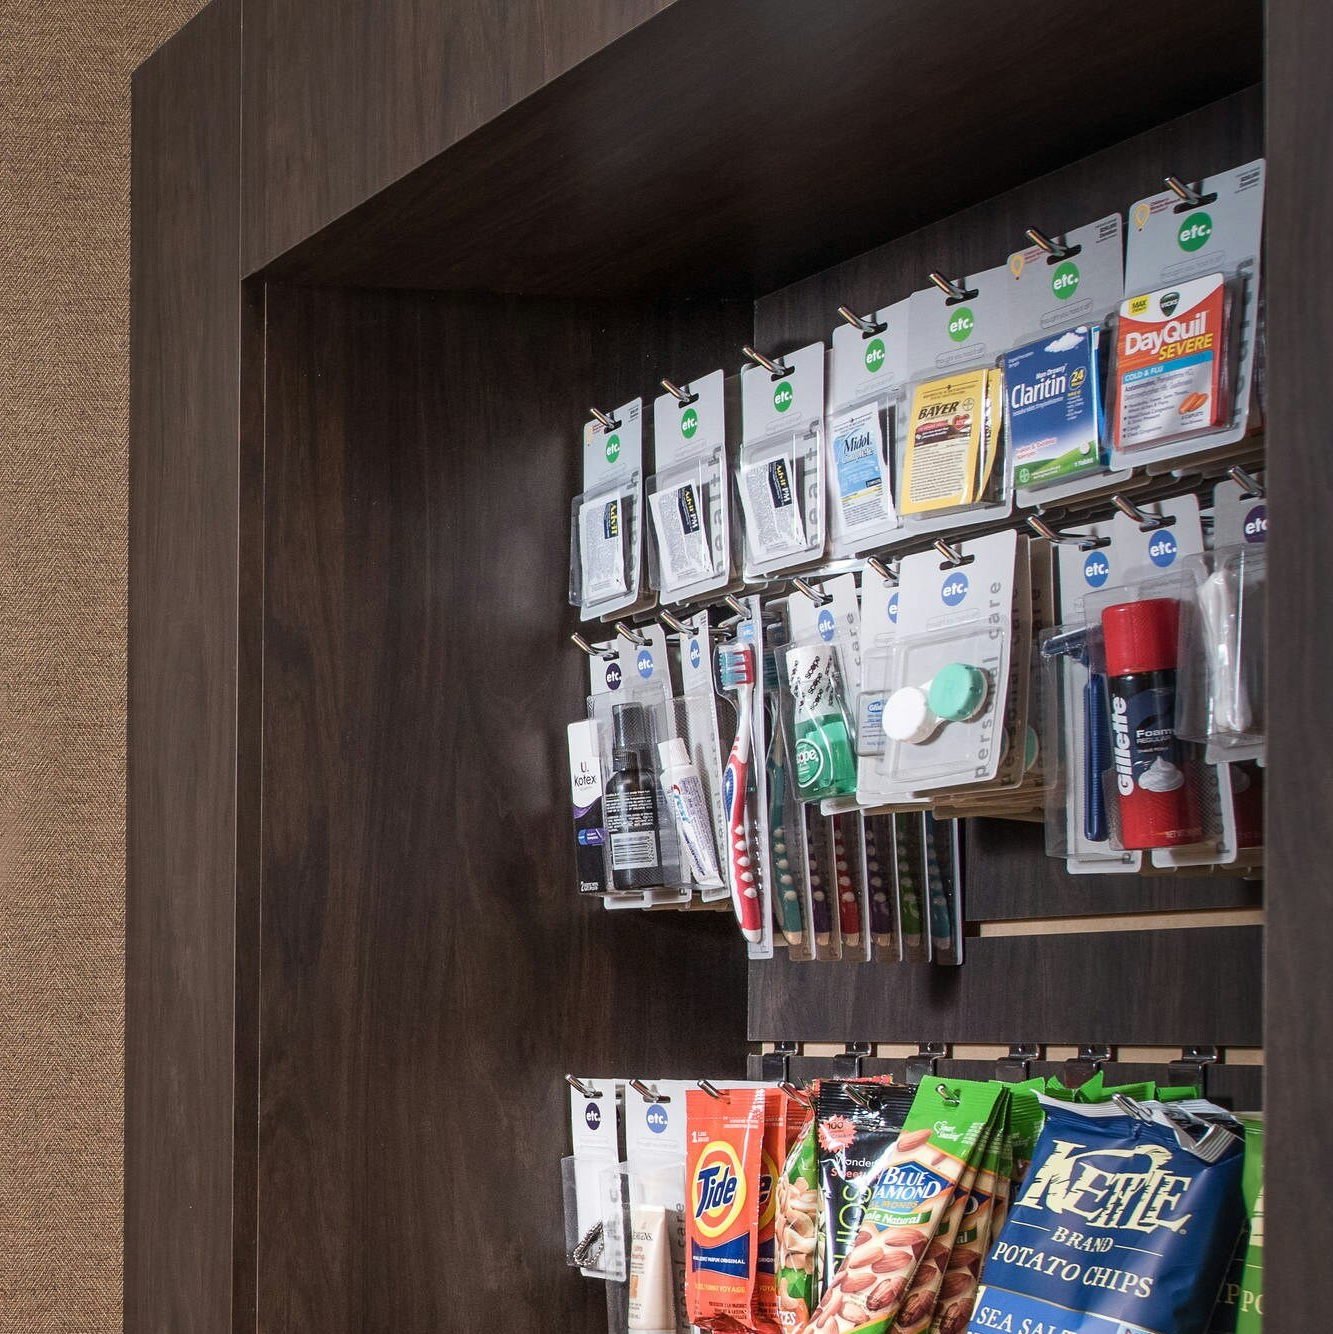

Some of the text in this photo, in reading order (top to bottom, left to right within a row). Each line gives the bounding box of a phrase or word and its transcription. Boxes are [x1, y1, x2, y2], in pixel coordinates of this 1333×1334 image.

[1124, 311, 1206, 355] DayQuil
[1159, 333, 1214, 361] SEVERE
[1125, 371, 1142, 382] COLD
[1150, 366, 1164, 376] FLU
[1012, 374, 1066, 409] Claritin
[918, 401, 960, 420] BAYER
[844, 432, 871, 454] Midol
[1112, 696, 1135, 797] Gillette
[883, 1167, 931, 1186] BLUE
[695, 1167, 738, 1220] Tide
[1051, 1225, 1114, 1253] BRAND
[992, 1241, 1154, 1299] POTATO CHIPS
[976, 1306, 1013, 1333] SEA
